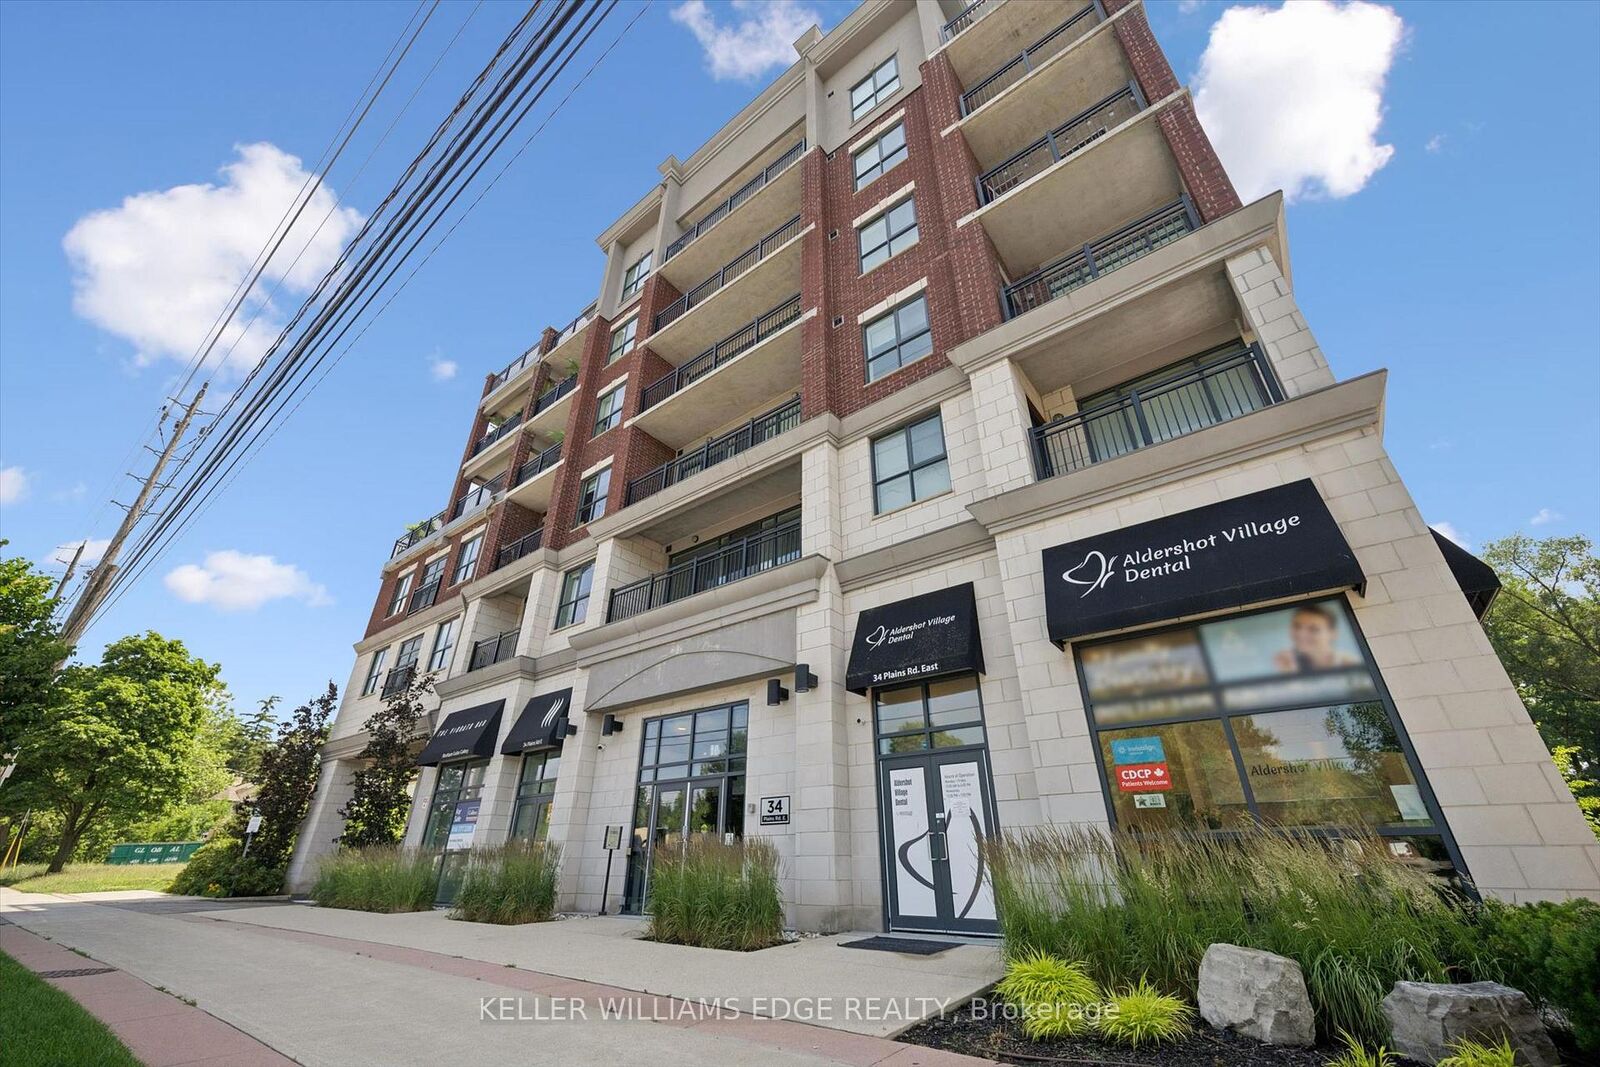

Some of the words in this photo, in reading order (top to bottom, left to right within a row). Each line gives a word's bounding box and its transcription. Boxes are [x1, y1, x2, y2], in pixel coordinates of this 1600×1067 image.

[1123, 534, 1217, 568] Aldershot
[1222, 513, 1301, 542] Village
[1125, 555, 1191, 583] Dental
[889, 621, 926, 636] Aldershot
[927, 614, 956, 627] Village
[888, 631, 914, 645] Dental
[873, 674, 883, 682] 34
[883, 669, 906, 681] Plains
[907, 665, 920, 676] Rd.
[921, 662, 939, 673] East
[1121, 768, 1152, 780] CDCP
[767, 800, 783, 813] 34
